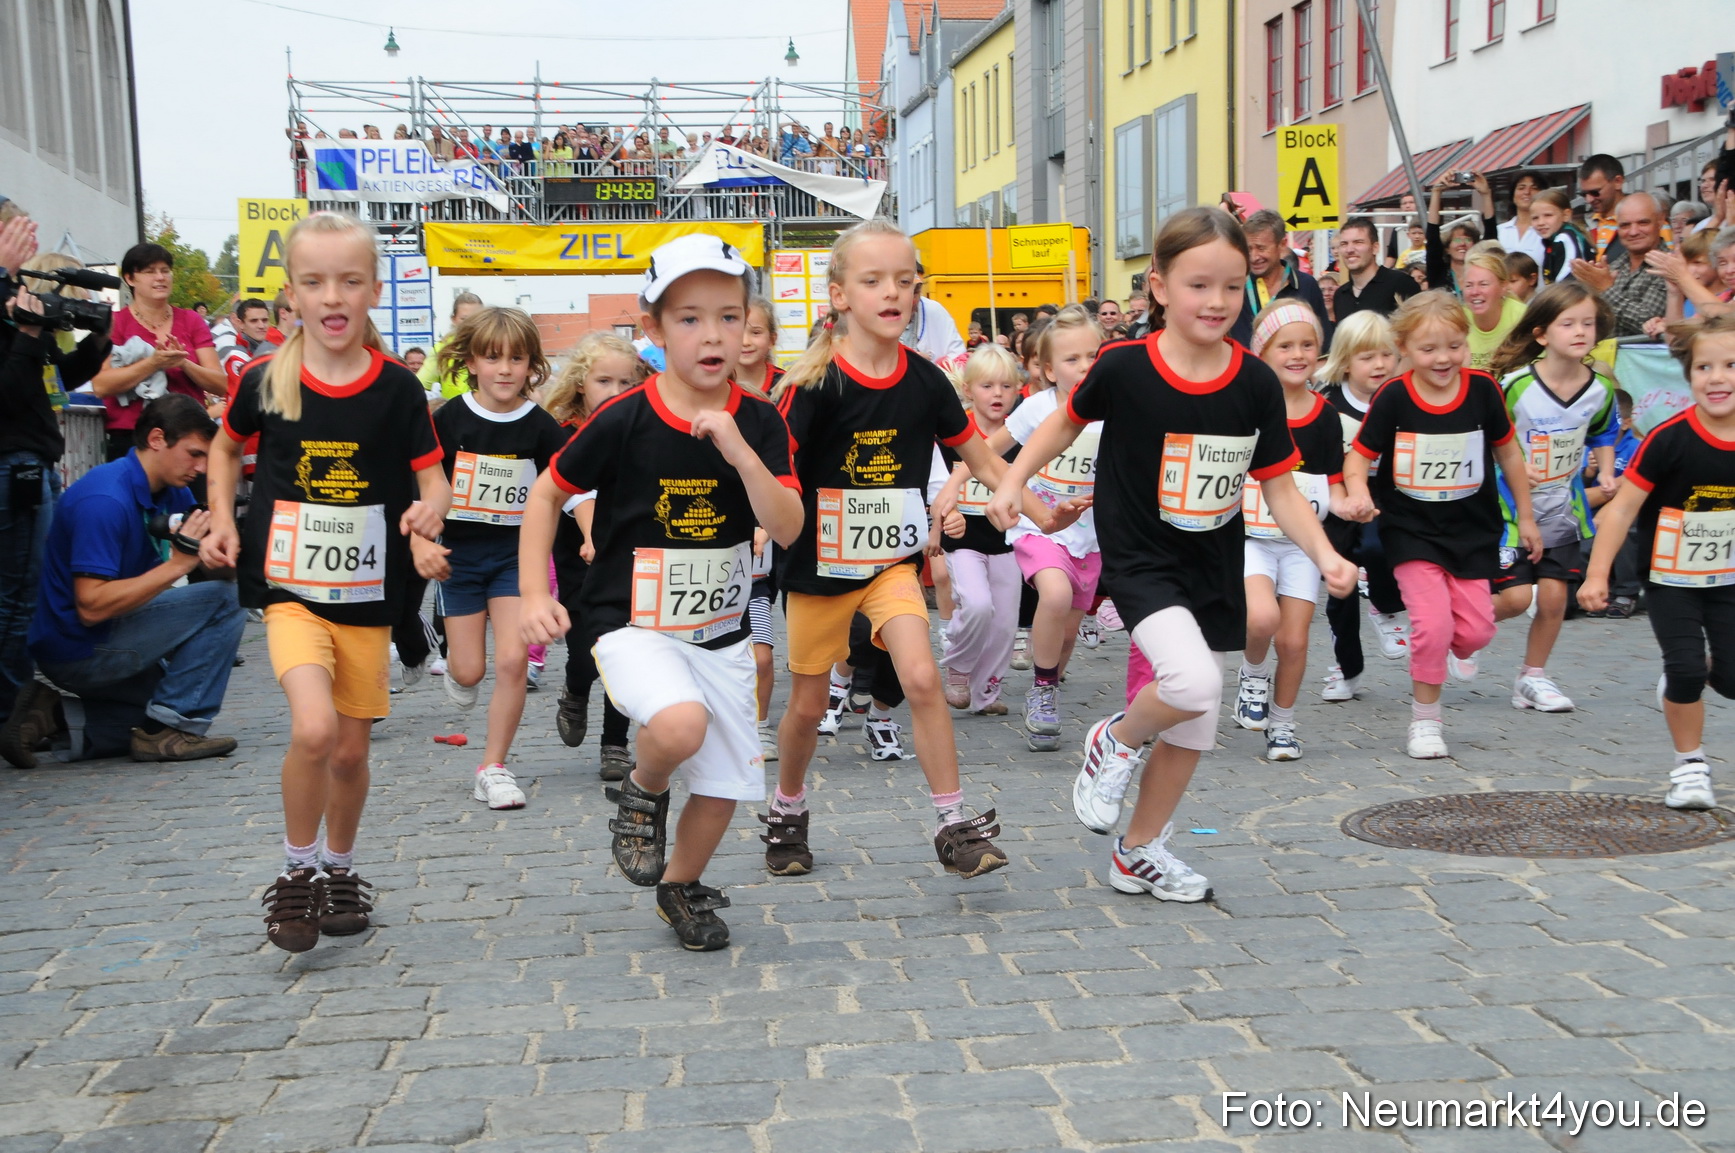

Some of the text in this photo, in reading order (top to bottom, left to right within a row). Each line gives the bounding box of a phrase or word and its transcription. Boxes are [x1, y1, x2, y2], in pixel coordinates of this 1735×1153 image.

[1285, 129, 1337, 149] Block
[1292, 156, 1332, 208] A
[247, 202, 301, 221] Block
[559, 233, 635, 260] ZIEL
[1012, 237, 1068, 248] Schnupper-
[255, 229, 291, 278] A
[1032, 248, 1050, 258] lauf
[301, 440, 360, 451] NEUMARKTER
[305, 449, 355, 458] STADTLAUF
[1198, 443, 1253, 463] Victoria
[479, 461, 514, 478] Hanna
[1420, 460, 1473, 480] 7271
[659, 478, 719, 487] NEUMARKTER
[664, 487, 713, 496] STADTLAUF
[478, 483, 529, 504] 7168
[848, 497, 890, 514] Sarah
[304, 512, 354, 534] Louisa
[671, 515, 727, 527] BAMBINILAUF
[849, 524, 919, 550] 7083
[305, 544, 377, 572] 7084
[670, 584, 742, 616] 7262
